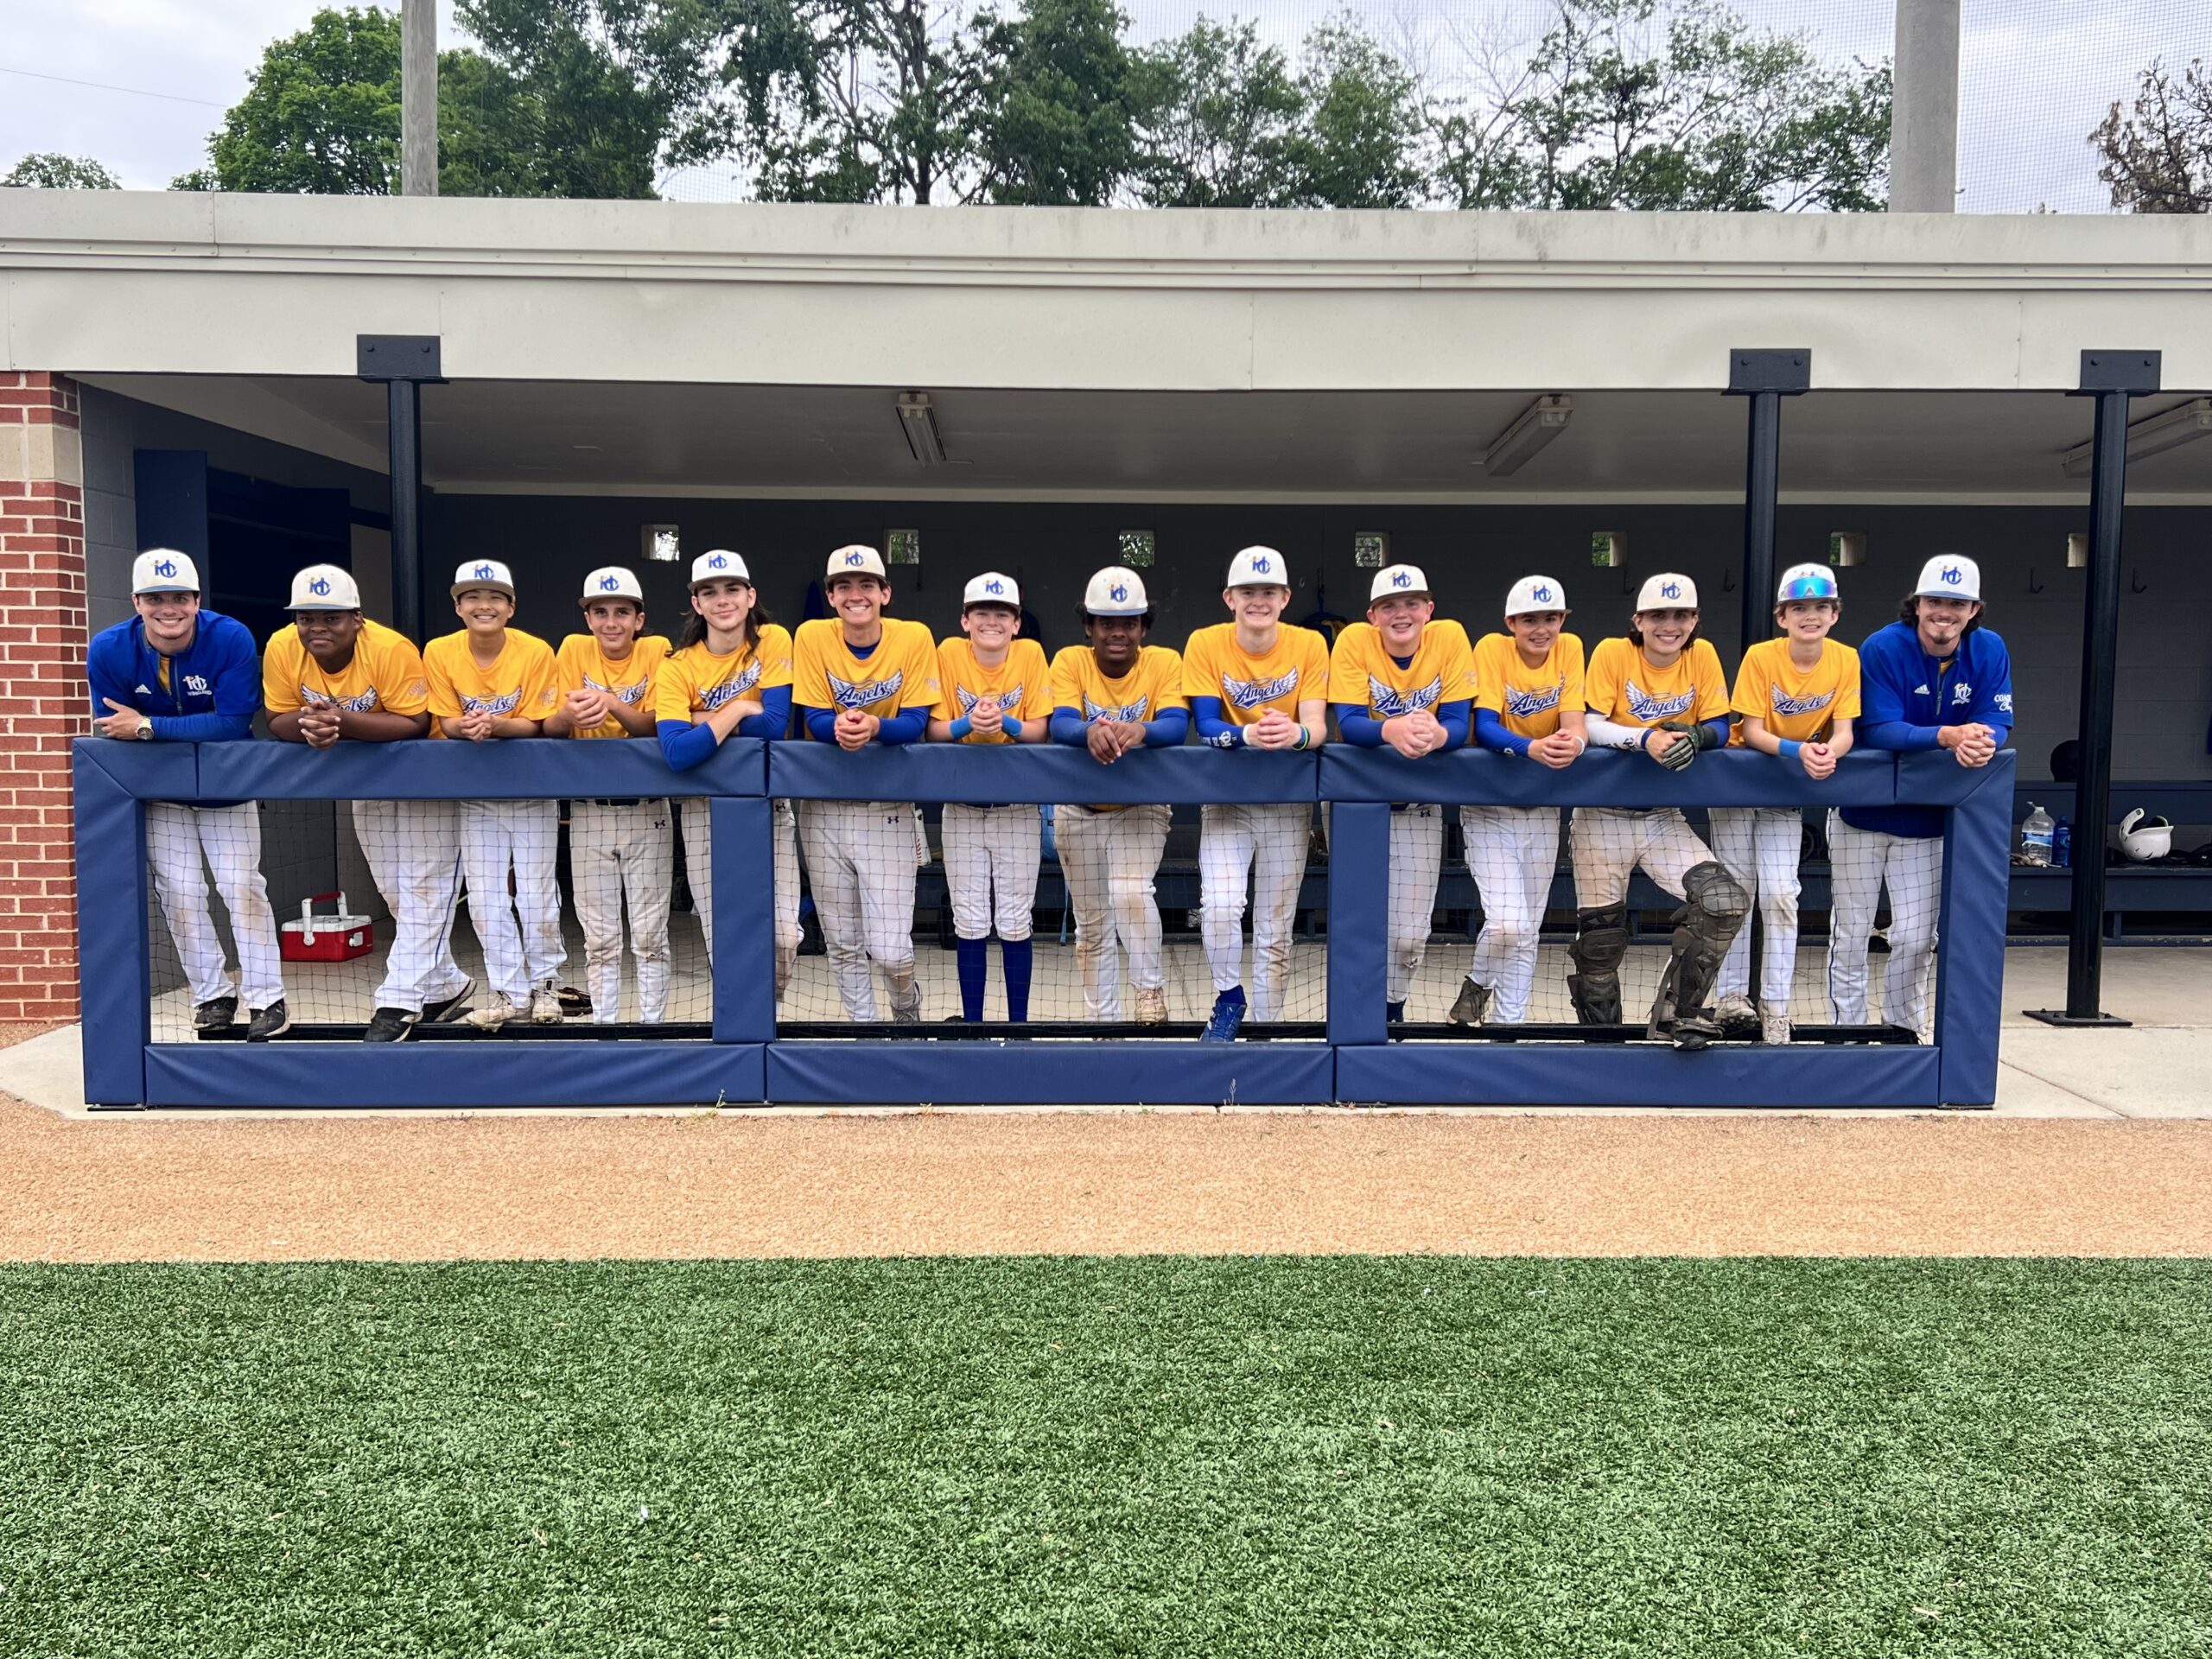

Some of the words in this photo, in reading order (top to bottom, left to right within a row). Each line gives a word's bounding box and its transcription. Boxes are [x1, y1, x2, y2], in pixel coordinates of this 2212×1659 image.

[836, 681, 888, 705] Angels
[1232, 680, 1285, 706] Angels
[1509, 688, 1559, 714] Angel
[1629, 696, 1688, 718] Angels
[1774, 696, 1822, 715] Angels
